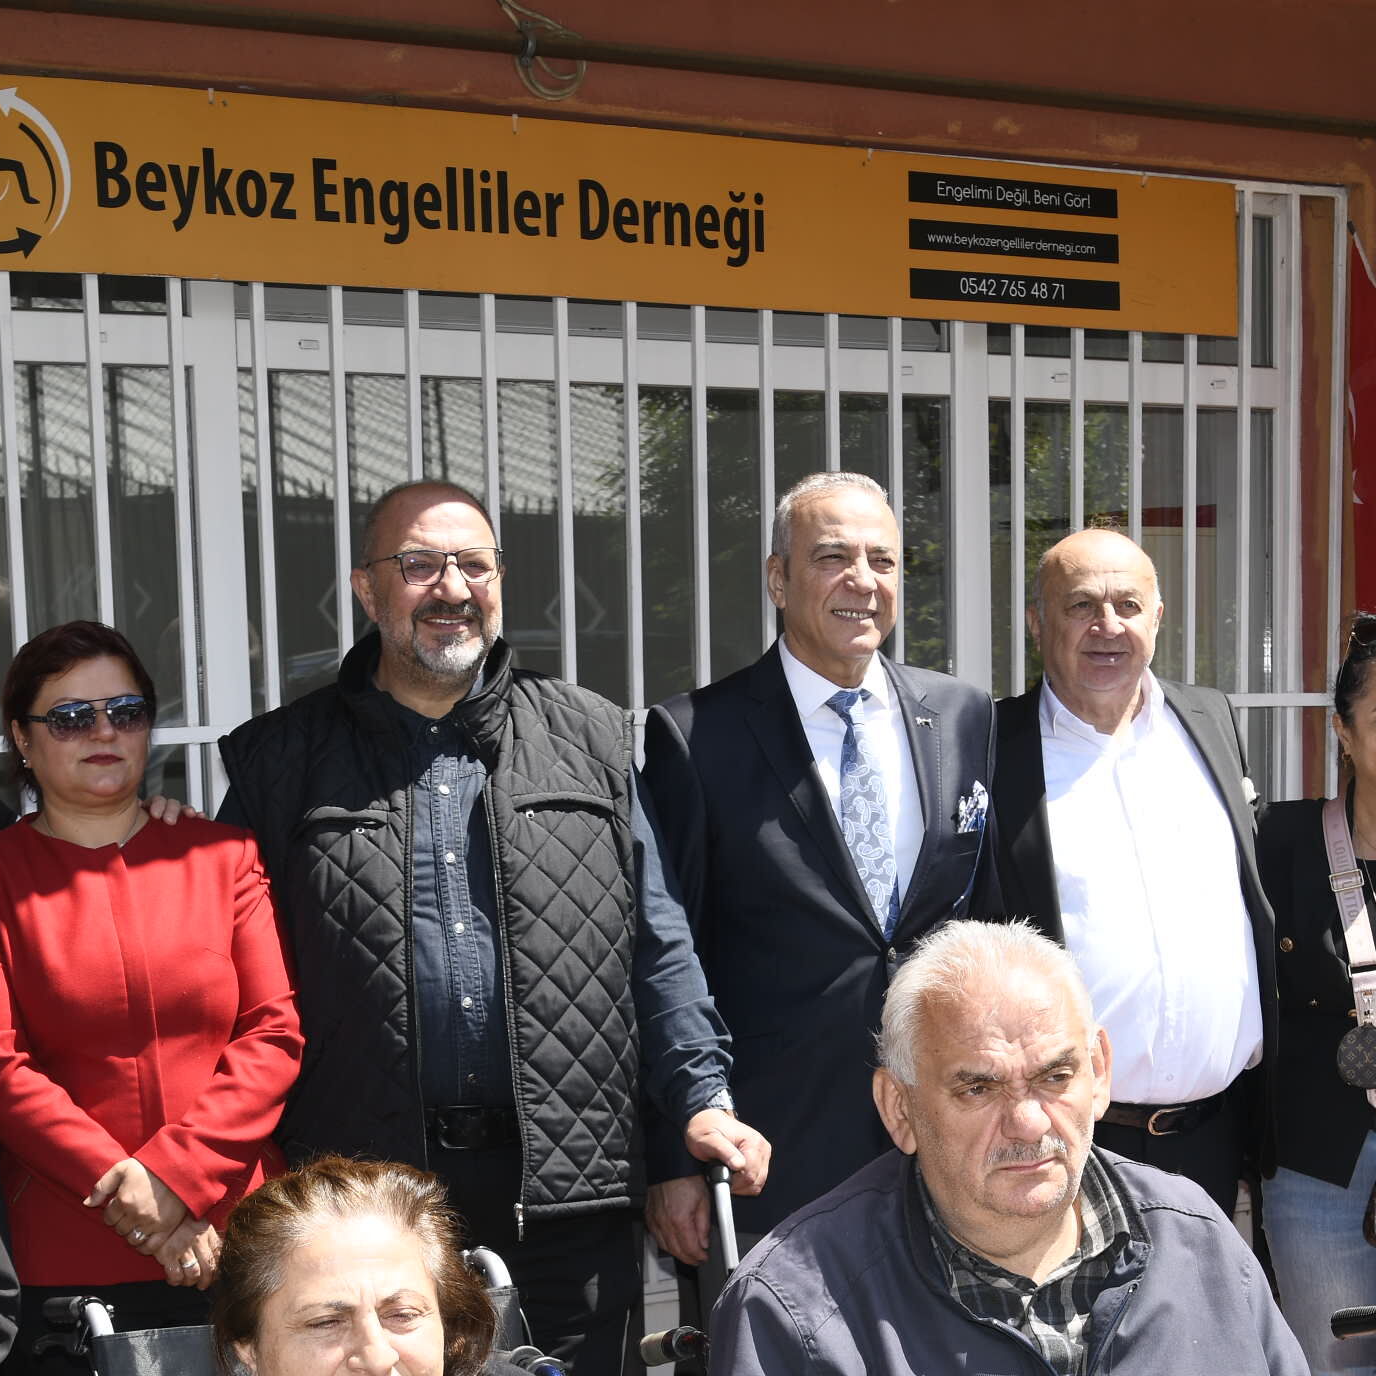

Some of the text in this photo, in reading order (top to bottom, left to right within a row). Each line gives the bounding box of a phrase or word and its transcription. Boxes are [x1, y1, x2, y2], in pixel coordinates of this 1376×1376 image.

[93, 140, 766, 268] Beykoz Engelliler Derneği
[936, 180, 1091, 209] Engelimi Değil, Beni Gör!
[927, 232, 1096, 256] www.beykozengellilerdernegi.com
[960, 277, 1065, 301] 0542 765 48 71
